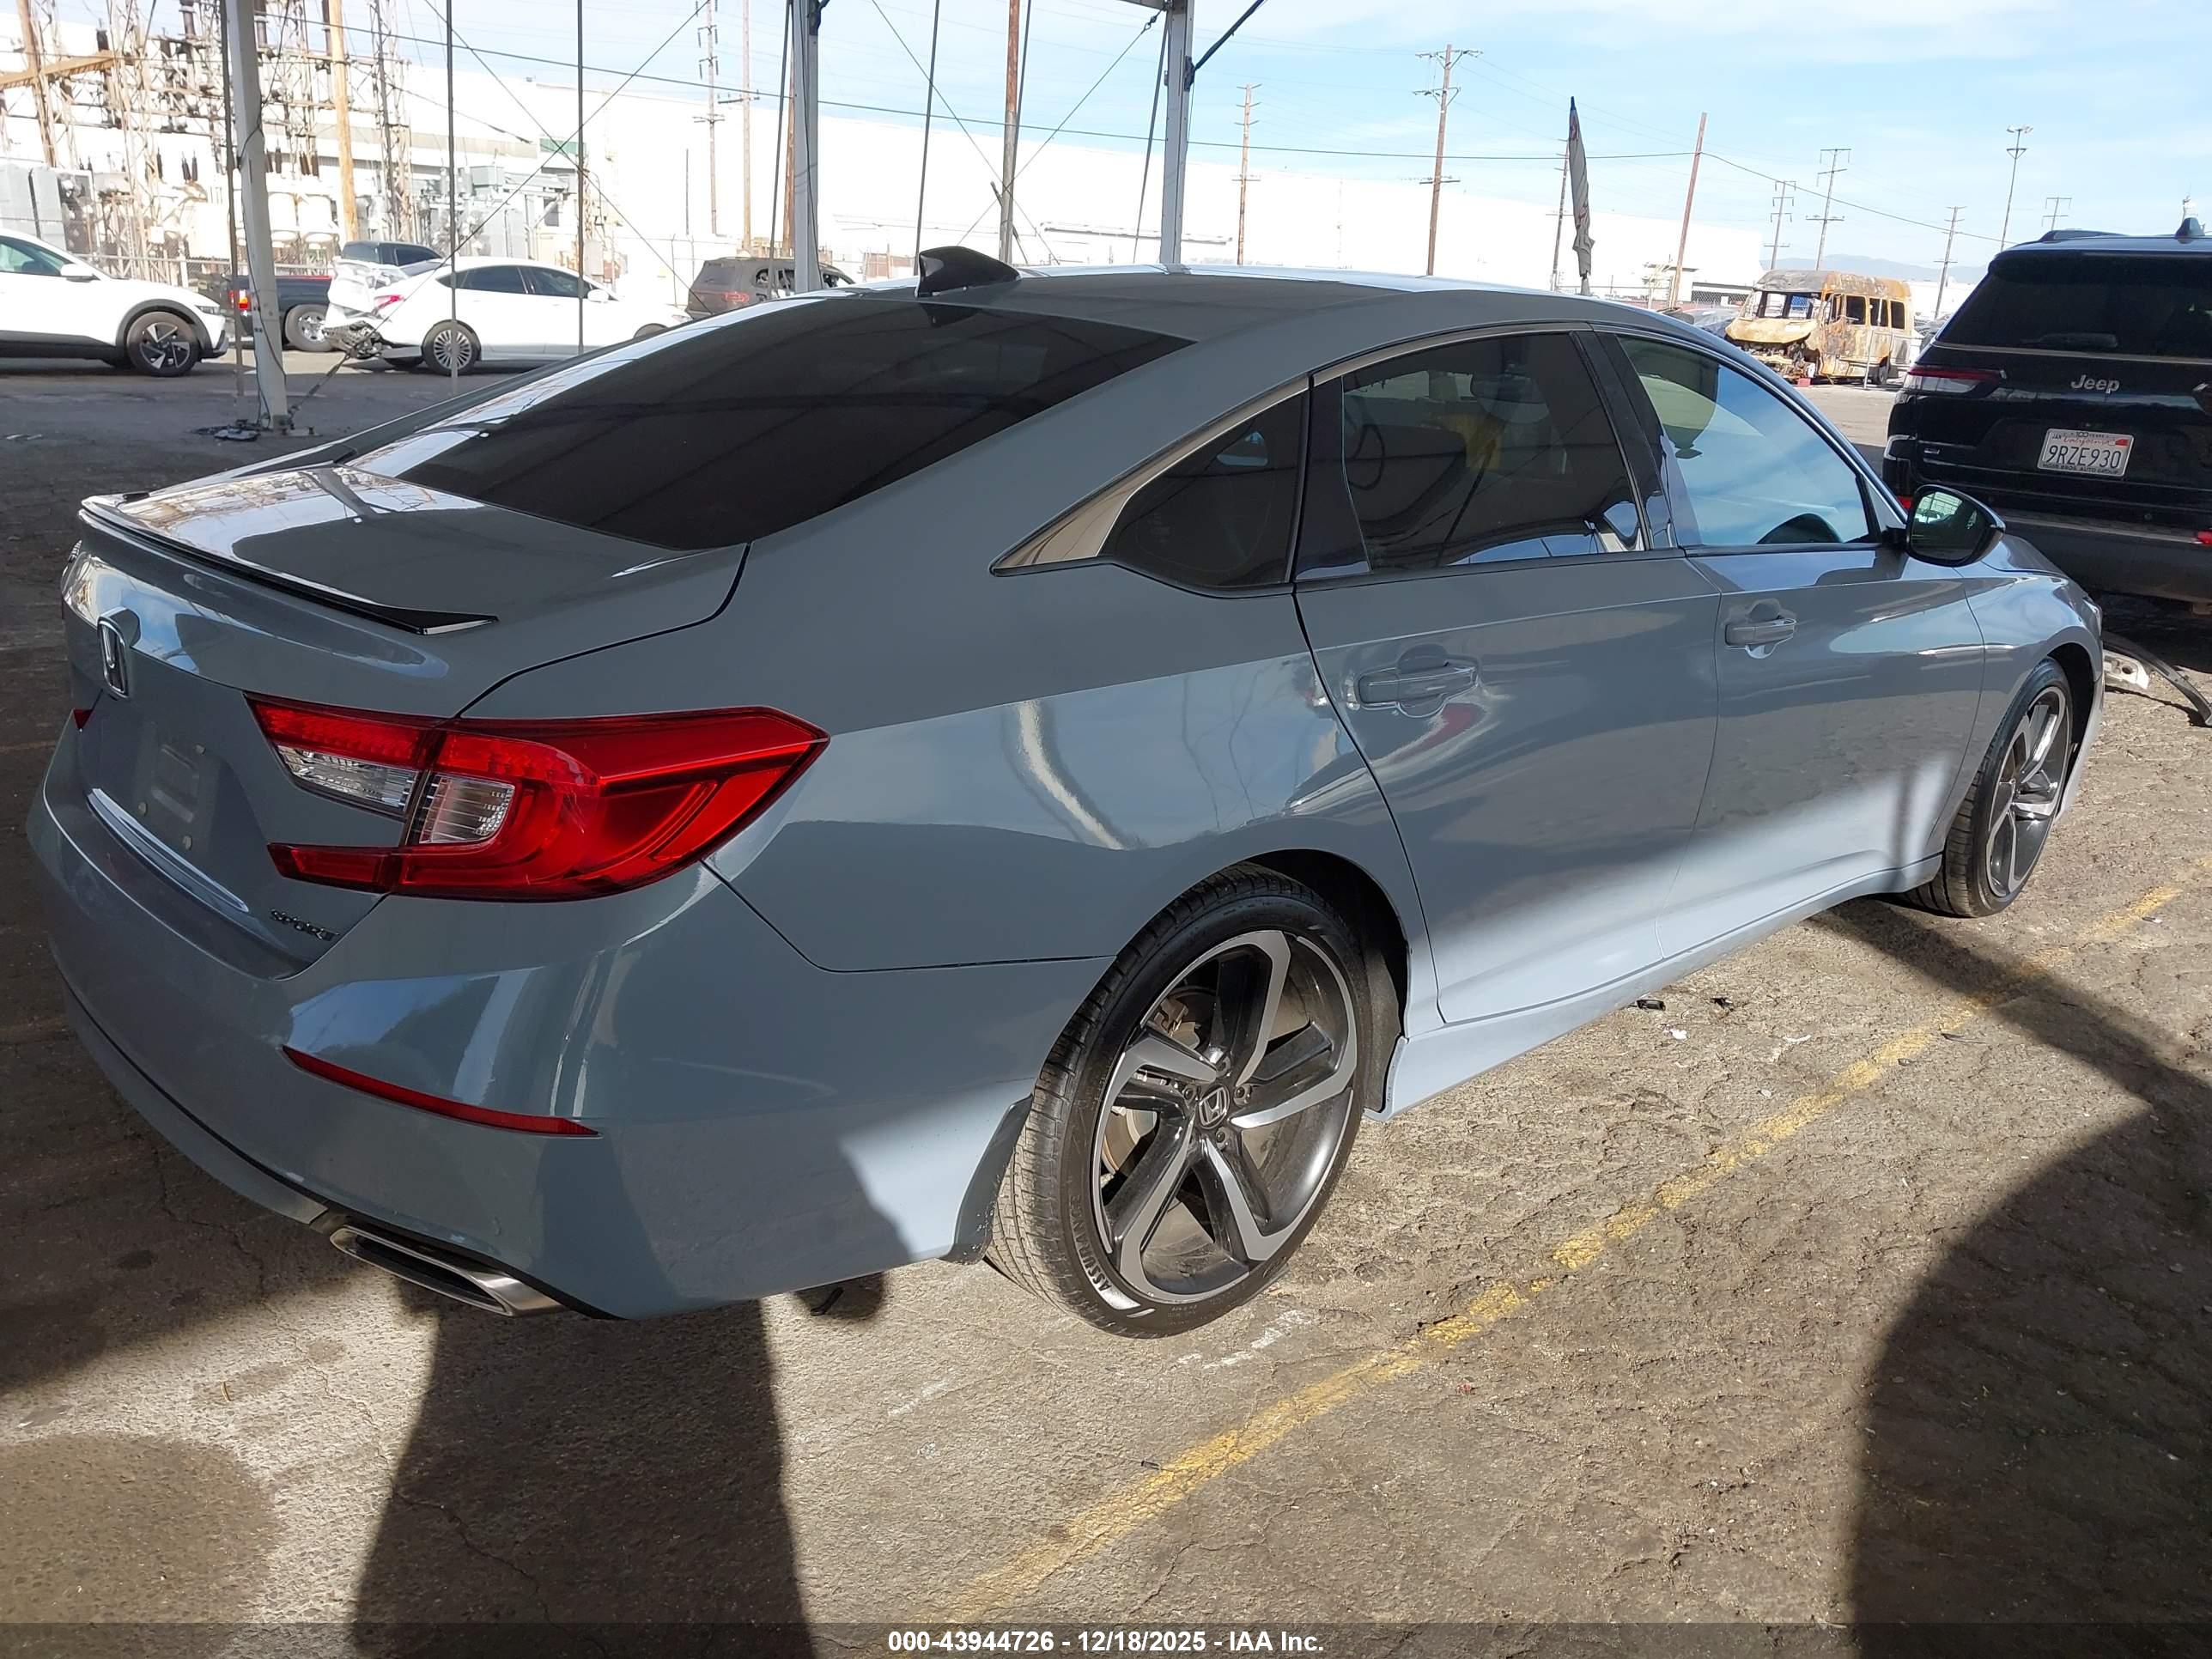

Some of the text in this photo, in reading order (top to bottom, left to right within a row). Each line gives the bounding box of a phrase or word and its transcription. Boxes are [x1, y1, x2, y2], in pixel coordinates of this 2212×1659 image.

[2070, 374, 2120, 394] Jeep
[2045, 445, 2122, 469] 9RZE930
[1069, 1194, 1113, 1292] ASSURANCE
